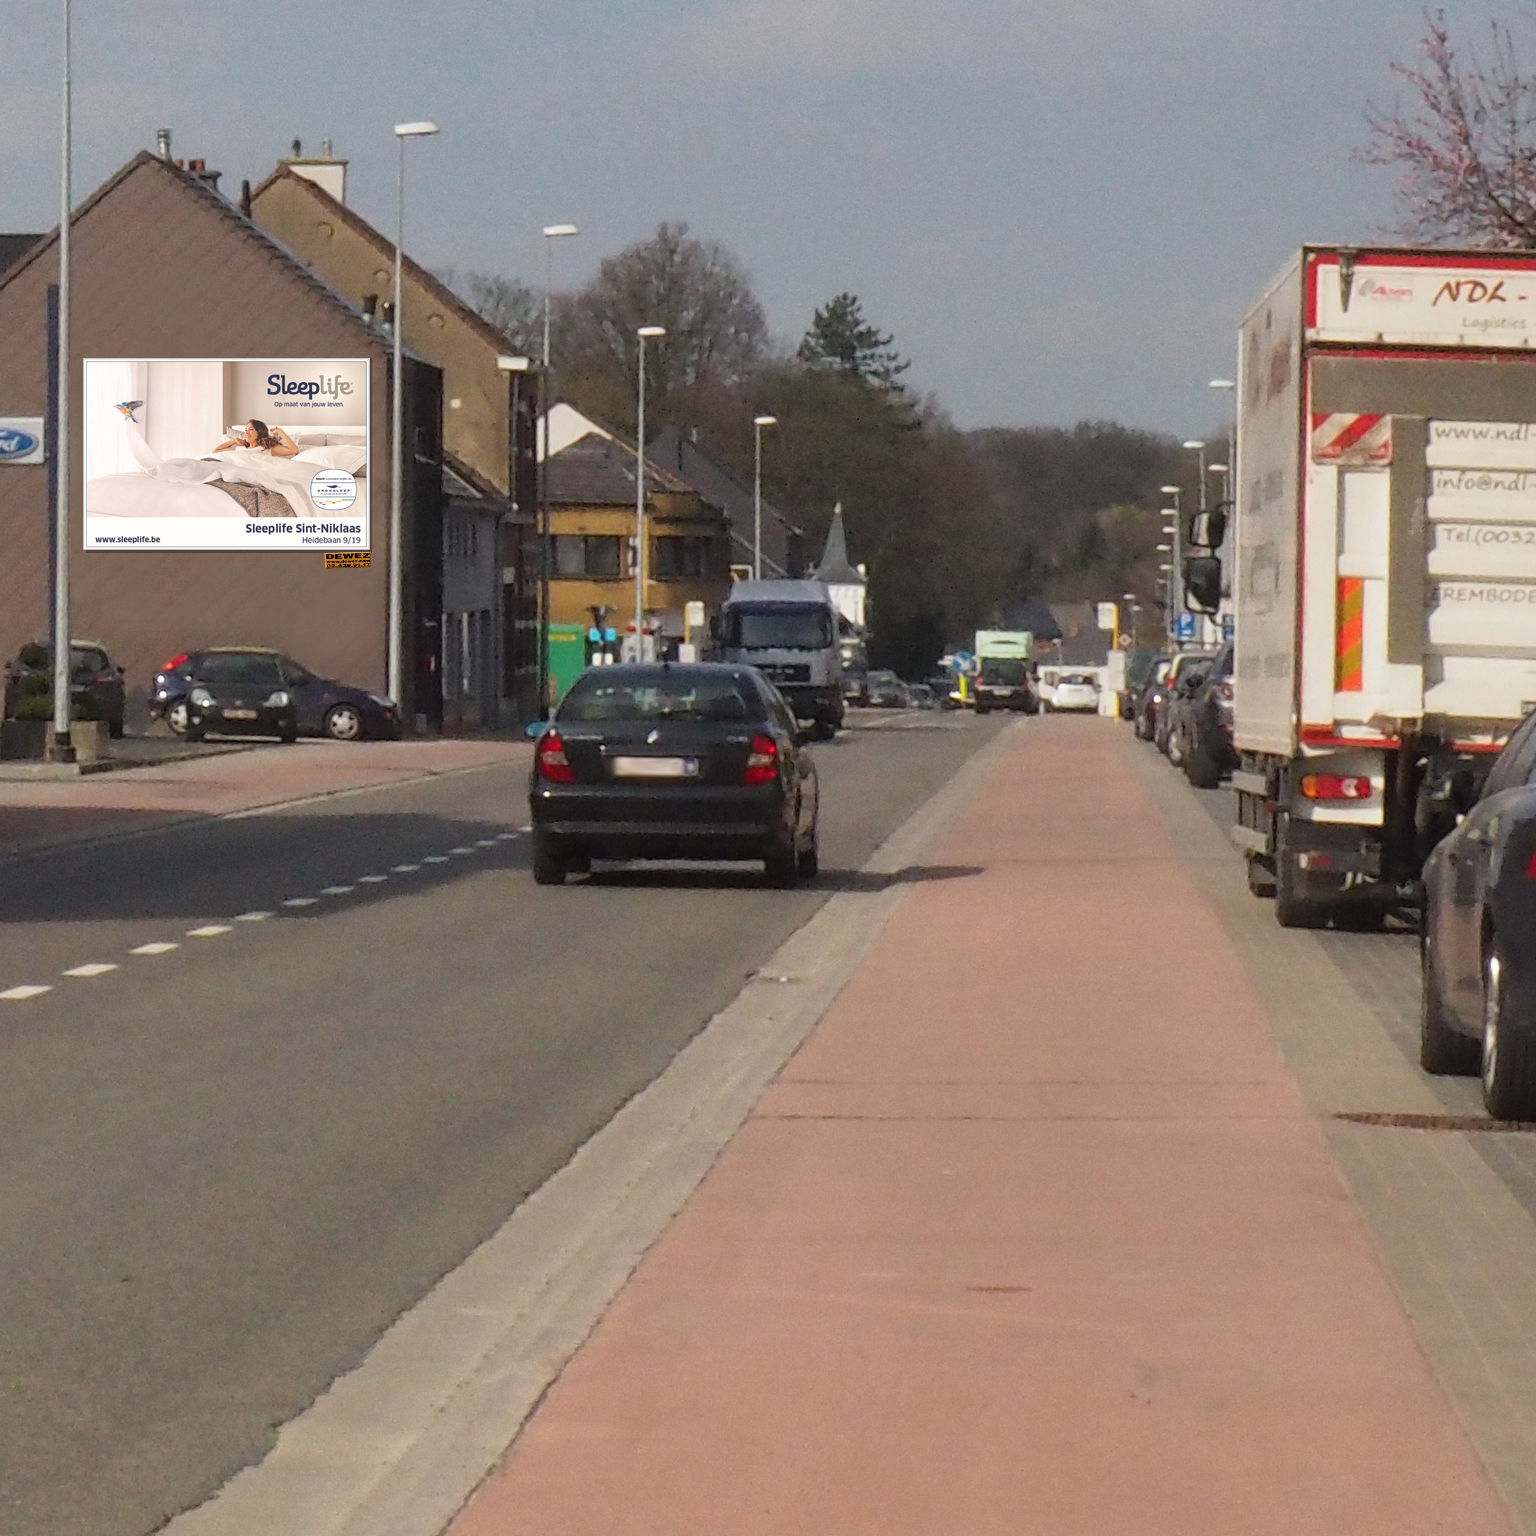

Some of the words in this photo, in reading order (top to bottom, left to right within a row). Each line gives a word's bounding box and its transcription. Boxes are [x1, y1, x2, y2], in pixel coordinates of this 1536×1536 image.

[1462, 316, 1527, 331] Logistics
[267, 374, 354, 400] Sleeplife
[246, 523, 293, 535] Sleeplife
[295, 523, 362, 534] Sint-Niklaas
[95, 535, 161, 545] www.sleeplife.be
[302, 536, 342, 544] Heidebaan
[343, 536, 362, 544] 9/19
